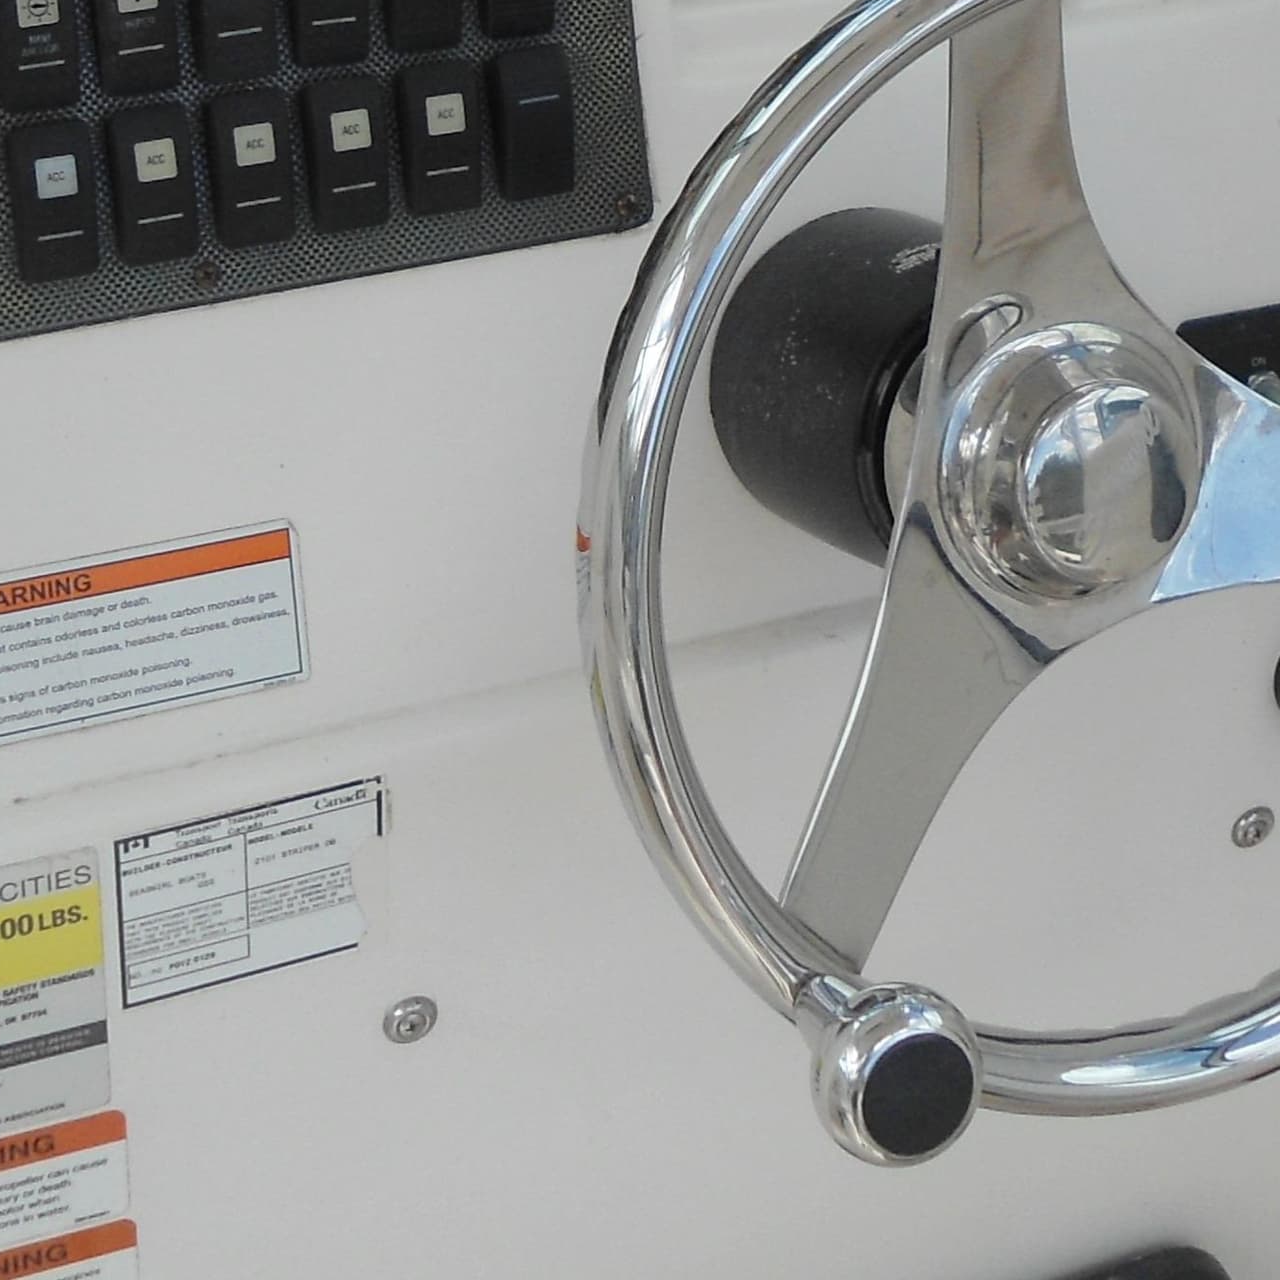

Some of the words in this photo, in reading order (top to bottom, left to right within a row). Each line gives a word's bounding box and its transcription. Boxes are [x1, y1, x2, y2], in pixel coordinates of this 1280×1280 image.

[437, 108, 455, 119] ACC
[342, 123, 361, 135] ACC
[245, 138, 265, 150] ACC
[146, 153, 166, 166] ACC
[46, 171, 65, 182] ACC
[0, 620, 32, 633] cause
[34, 613, 60, 627] brain
[62, 605, 104, 621] damage
[106, 602, 118, 612] or
[120, 596, 152, 610] death.
[8, 636, 52, 652] contains
[54, 627, 98, 643] odorless
[101, 621, 121, 633] and
[123, 613, 168, 629] colorless
[170, 605, 205, 620] carbon
[207, 595, 256, 612] monoxide
[258, 591, 278, 604] gas.
[42, 649, 79, 665] include
[81, 642, 122, 657] nausea,
[125, 630, 179, 648] headache,
[180, 620, 230, 636] dizziness,
[232, 607, 290, 626] drowsiness,
[8, 689, 36, 703] signs
[39, 685, 49, 696] of
[51, 679, 88, 694] carbon
[89, 668, 139, 686] monoxide
[141, 658, 192, 677] poisoning.
[45, 696, 94, 714] regarding
[96, 688, 132, 703] carbon
[134, 677, 184, 695] monoxide
[38, 905, 89, 932] LBS.
[2, 982, 38, 997] SAFETY
[40, 968, 95, 988] STANDARDS
[47, 1167, 70, 1180] can
[72, 1157, 108, 1174] cause
[22, 1188, 35, 1199] or
[28, 1195, 60, 1210] when
[23, 1211, 34, 1221] in
